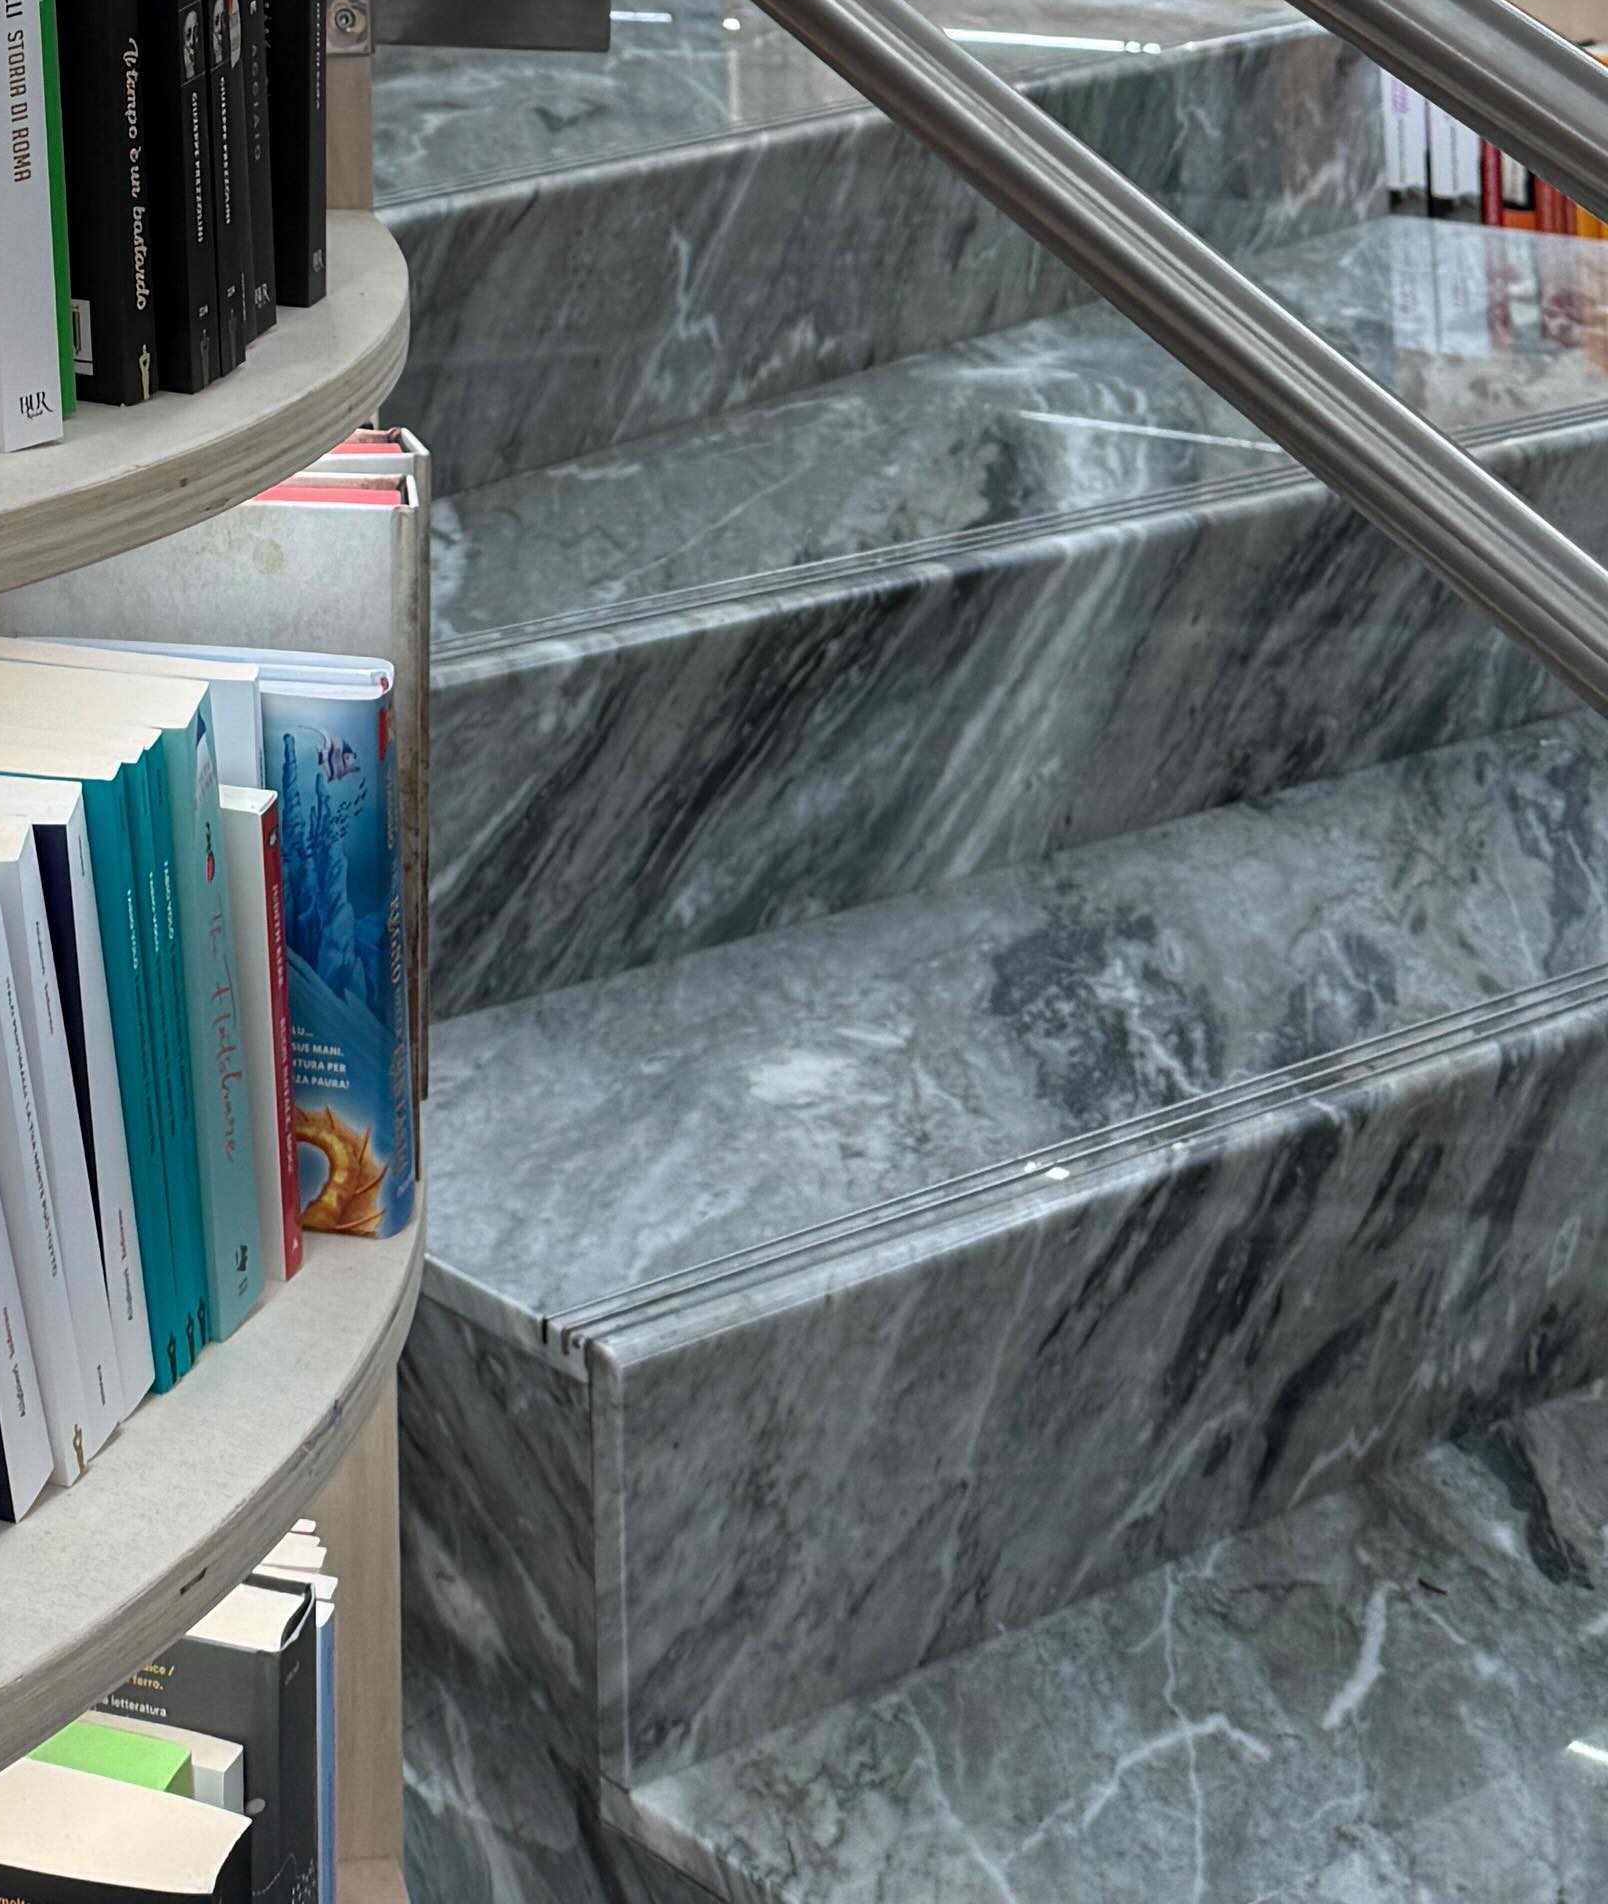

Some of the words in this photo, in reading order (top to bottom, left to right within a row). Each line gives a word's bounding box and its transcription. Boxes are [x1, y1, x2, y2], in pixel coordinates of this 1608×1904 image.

[7, 30, 26, 97] STORIA
[11, 102, 28, 122] DI
[12, 127, 31, 182] ROMA
